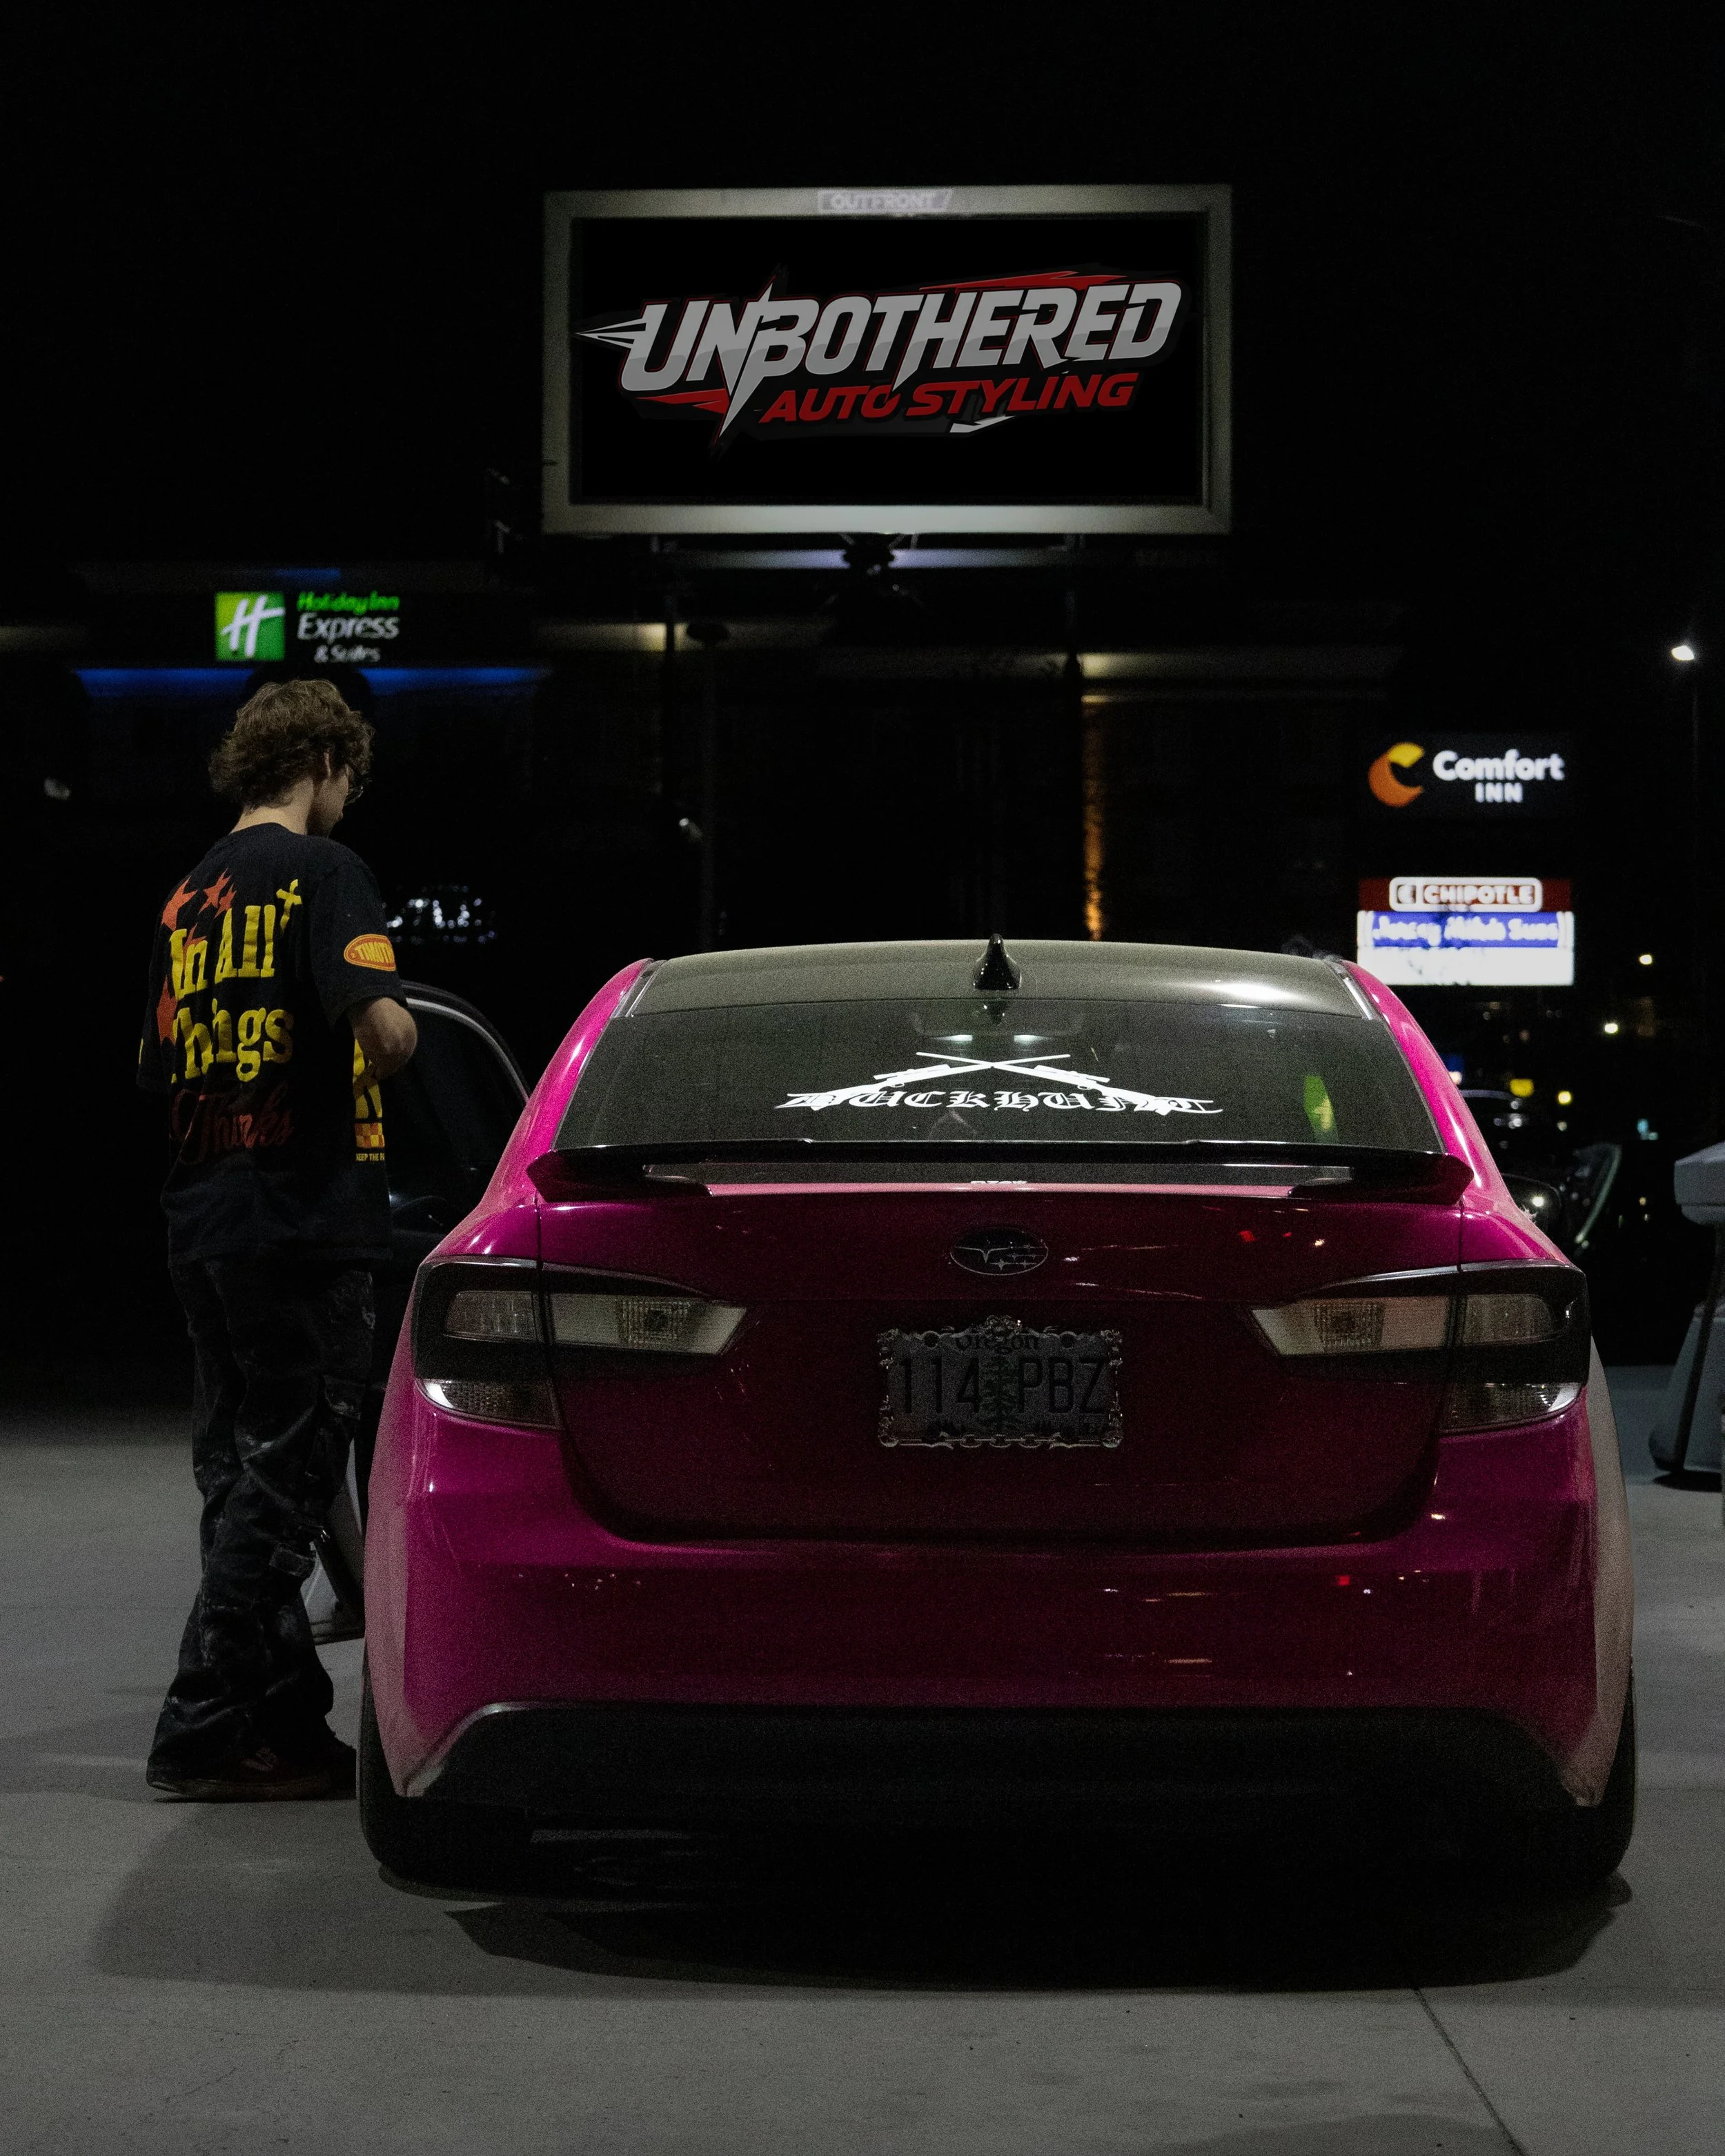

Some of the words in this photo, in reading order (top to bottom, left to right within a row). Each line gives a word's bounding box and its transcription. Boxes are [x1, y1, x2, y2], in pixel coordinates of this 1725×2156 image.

[830, 192, 937, 210] OUTFRONT
[616, 280, 1183, 439] UNBOTHERED
[759, 384, 900, 424] AUTO
[906, 373, 1139, 417] STYLING
[297, 612, 400, 644] Express
[1432, 749, 1565, 781] Comfort
[1475, 782, 1524, 802] INN
[1423, 884, 1535, 904] CHIPOTLE
[368, 1153, 379, 1162] THE
[902, 1356, 980, 1414] 114
[1018, 1356, 1107, 1414] PBZ
